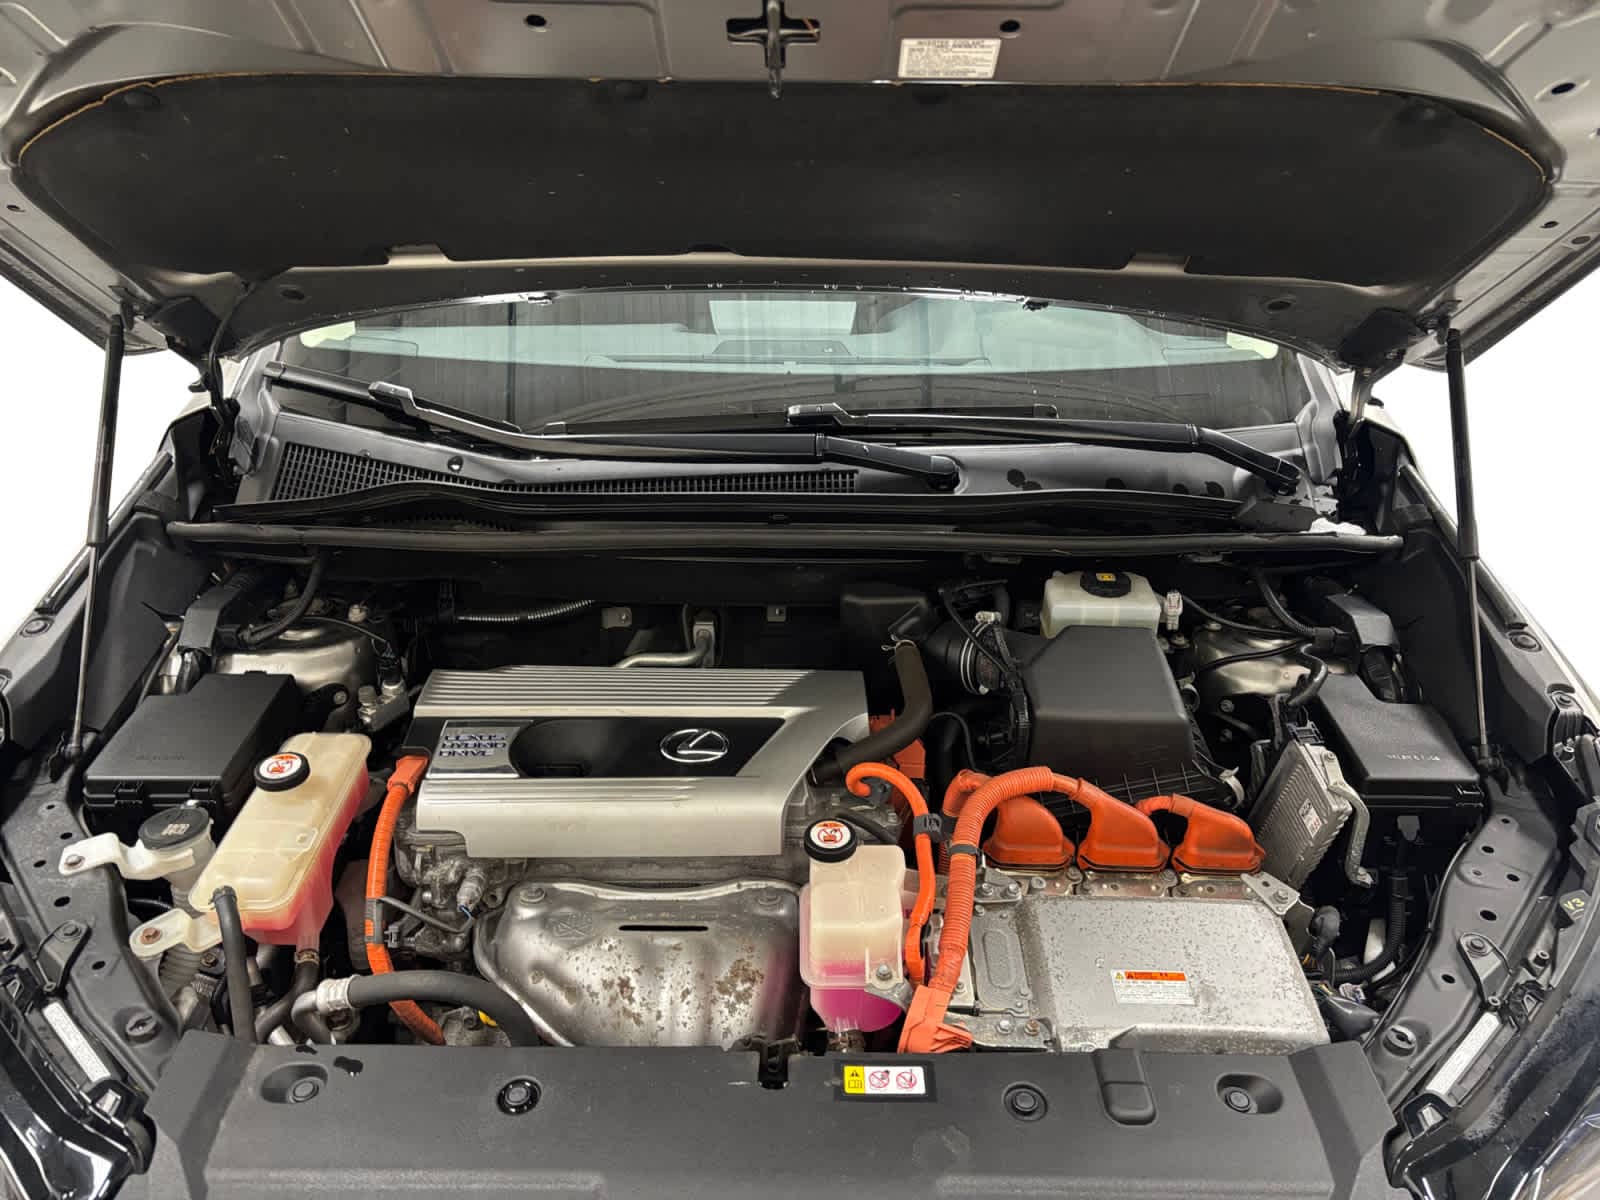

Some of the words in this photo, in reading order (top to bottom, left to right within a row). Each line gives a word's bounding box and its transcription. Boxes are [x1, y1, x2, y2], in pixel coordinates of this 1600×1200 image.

[444, 733, 507, 741] LEXUS
[441, 741, 507, 749] HYBRID
[439, 749, 494, 757] DRIVE
